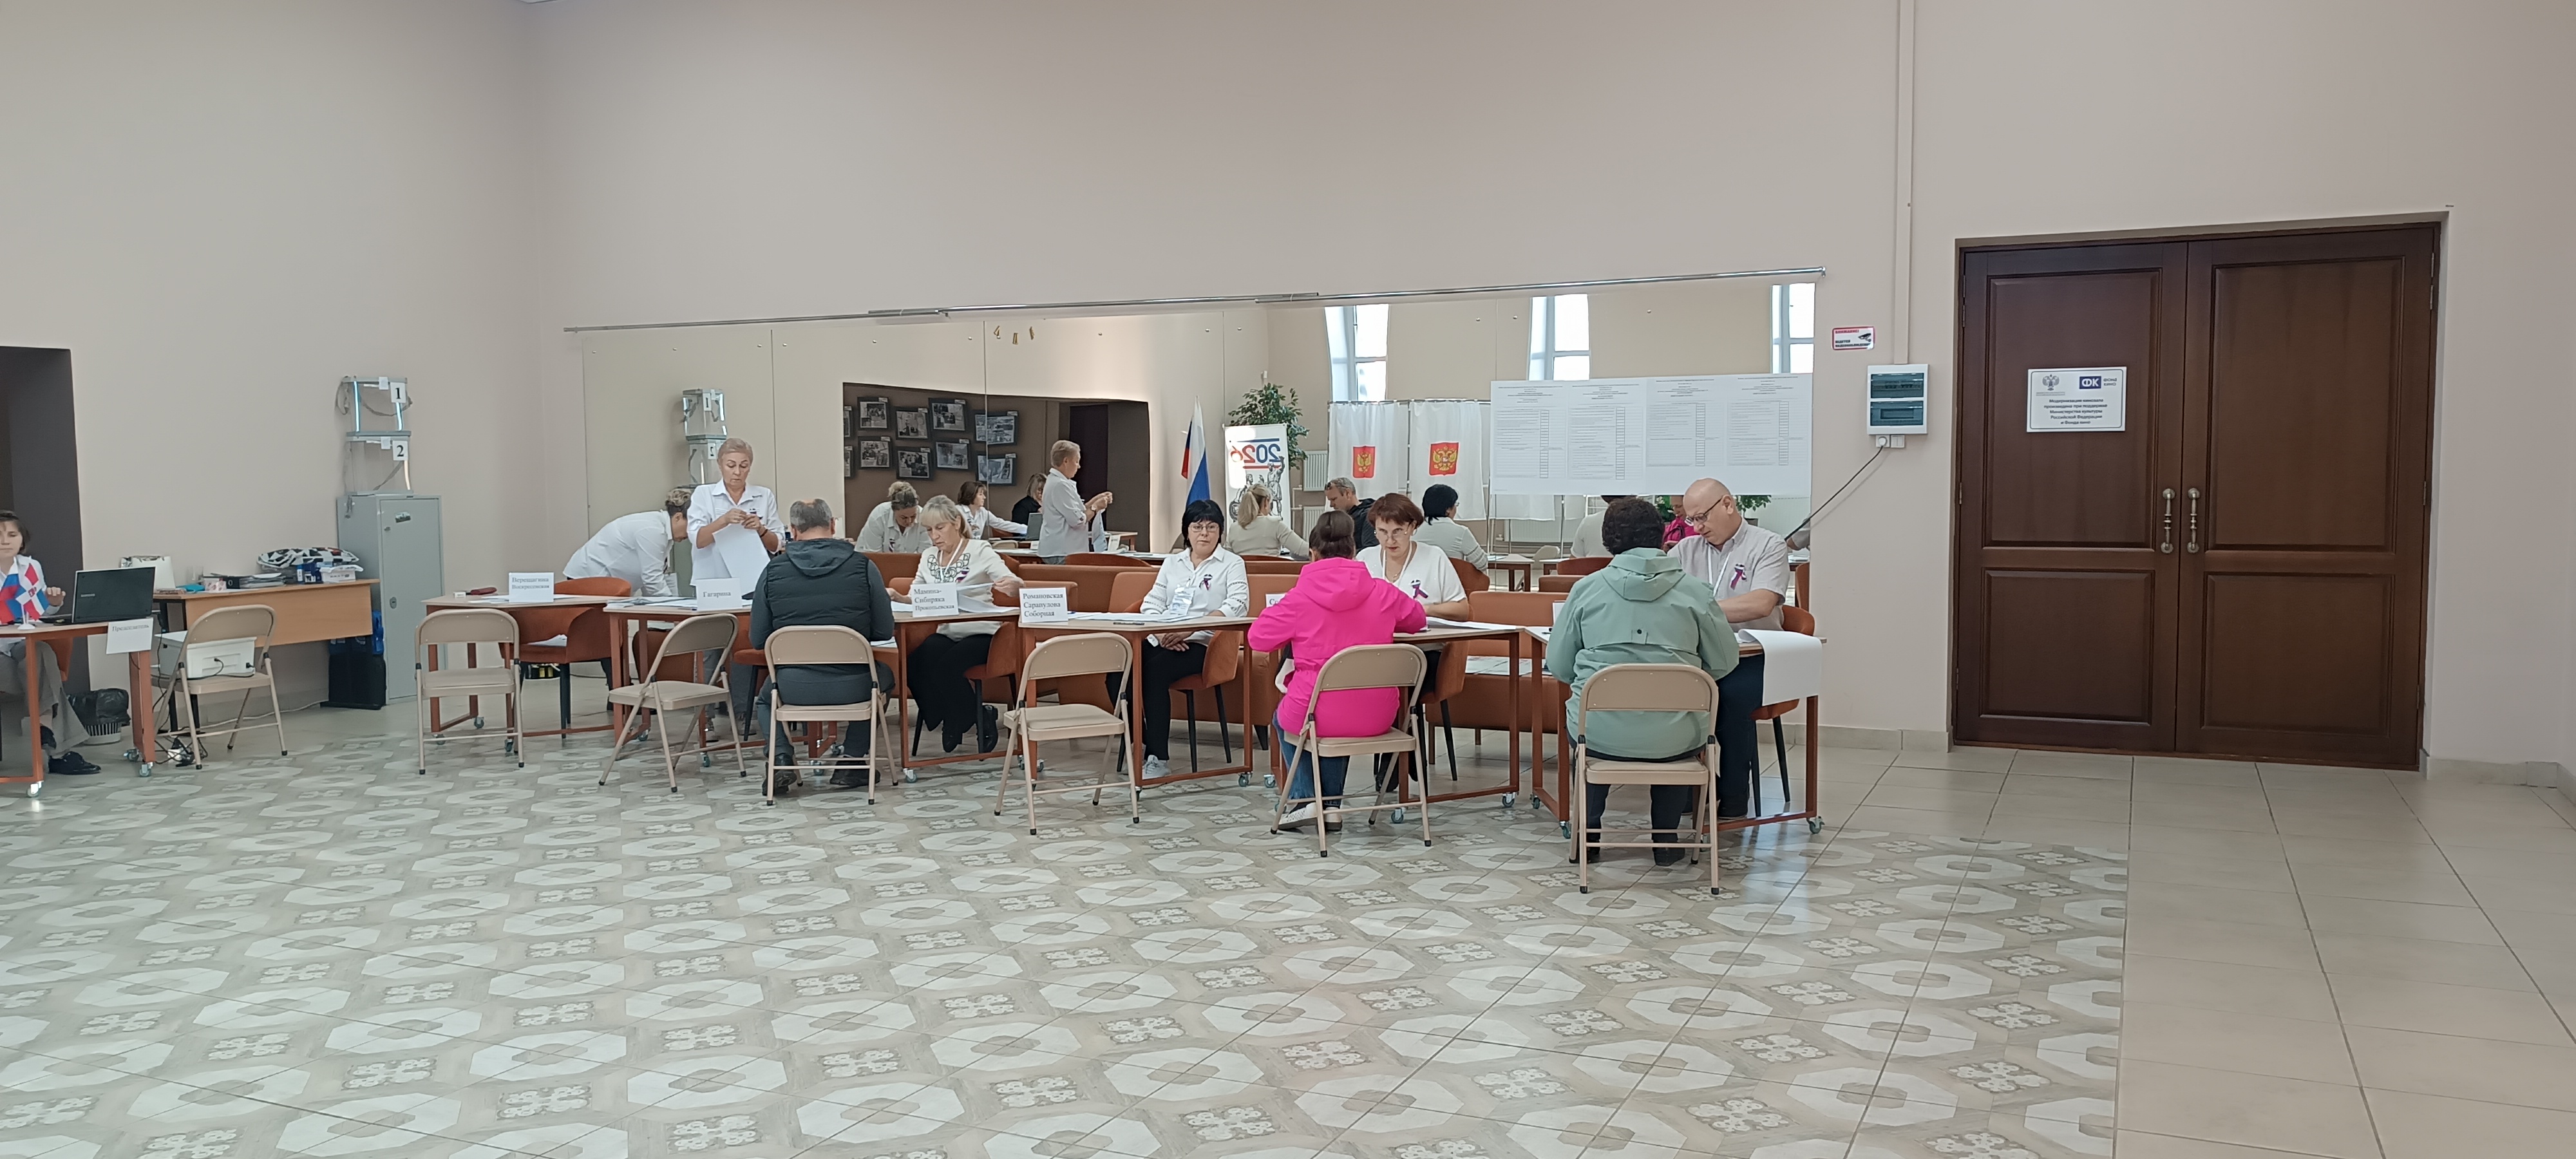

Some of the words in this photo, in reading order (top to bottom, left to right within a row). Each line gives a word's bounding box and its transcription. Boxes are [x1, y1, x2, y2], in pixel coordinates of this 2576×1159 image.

[2081, 378, 2099, 387] ФК
[395, 388, 401, 399] 1
[397, 445, 404, 457] 2
